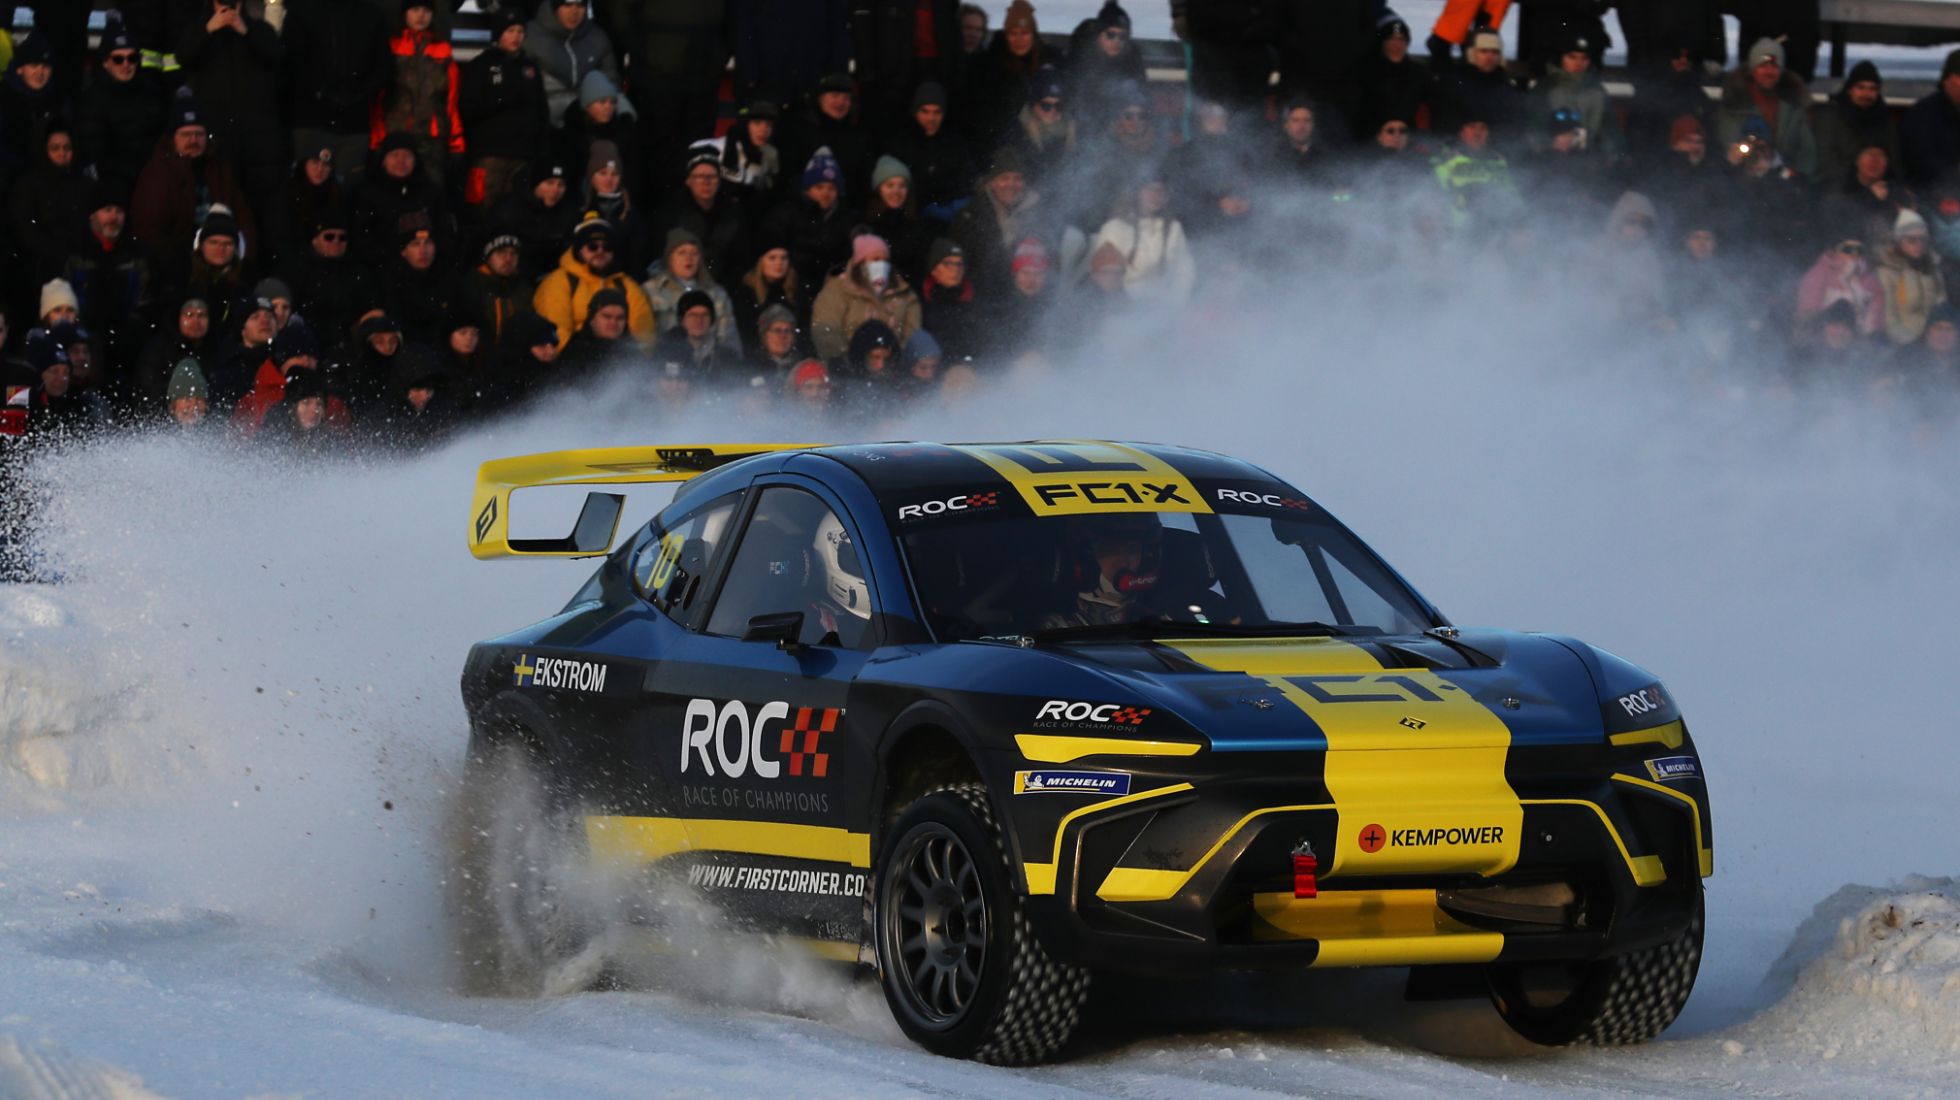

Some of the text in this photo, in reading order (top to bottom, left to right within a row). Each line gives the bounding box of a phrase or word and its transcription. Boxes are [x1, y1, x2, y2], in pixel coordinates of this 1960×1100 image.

[899, 495, 968, 519] ROC
[1217, 488, 1282, 507] ROC
[645, 532, 684, 589] 10
[532, 657, 607, 692] EKSTROM
[1035, 700, 1120, 722] ROC
[1619, 689, 1657, 717] ROC
[1033, 721, 1057, 729] RACE
[681, 698, 789, 779] ROC
[1046, 777, 1116, 788] MICHELIN
[683, 785, 829, 812] RACE OF CHAMPIONS
[1391, 827, 1504, 846] KEMPOWER
[687, 864, 868, 897] WWW.FIRSTCORNER.CO
